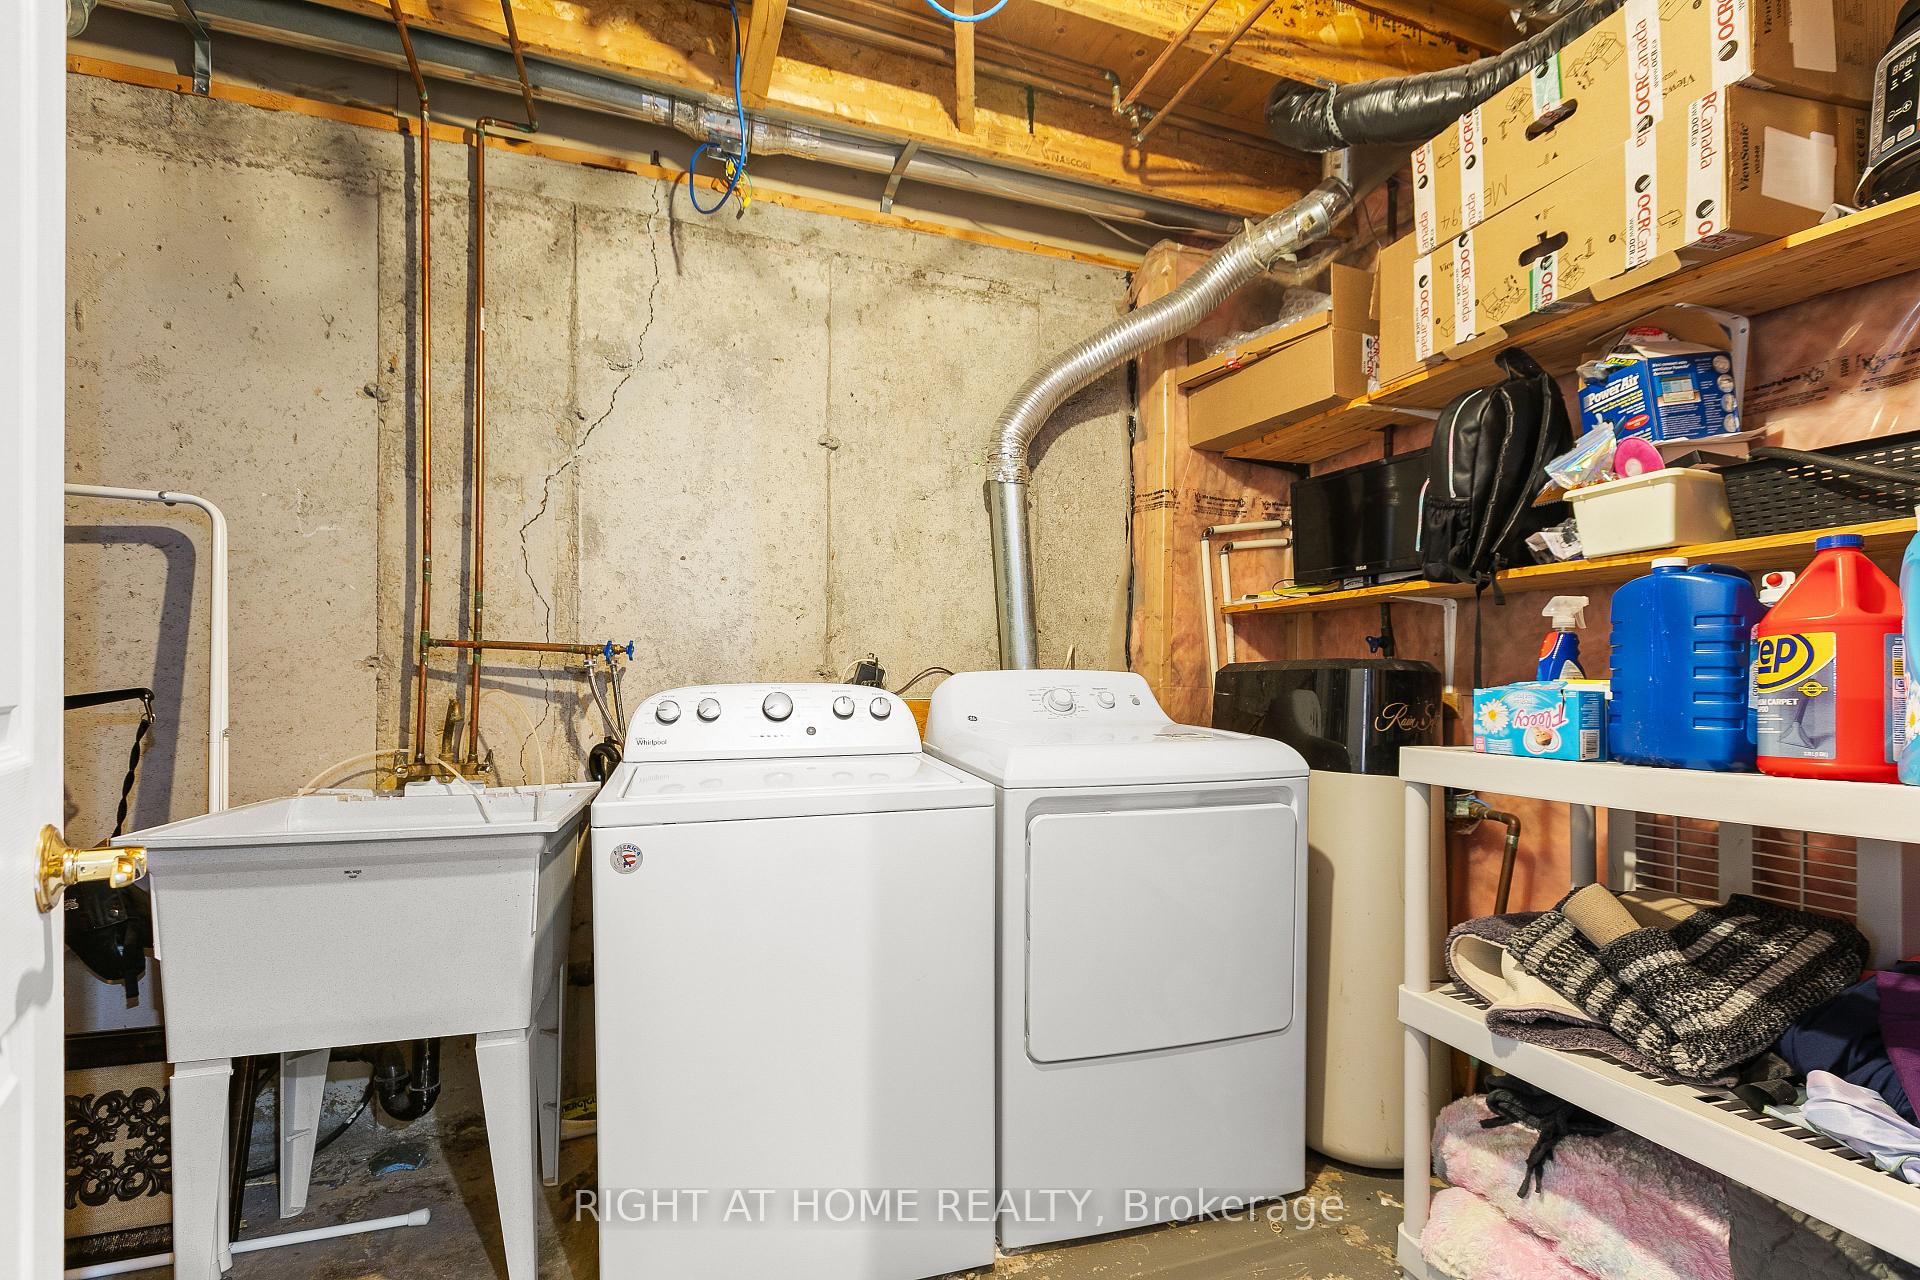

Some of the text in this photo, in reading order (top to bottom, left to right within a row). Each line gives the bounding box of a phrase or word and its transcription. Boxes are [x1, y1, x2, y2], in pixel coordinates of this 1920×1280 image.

[1632, 18, 1651, 115] OCRCanada
[1739, 123, 1750, 193] ViewSonic
[1758, 636, 1798, 673] ep
[1513, 703, 1568, 728] Fleecy
[1767, 698, 1800, 706] CARPET
[636, 739, 668, 747] Whirlpool
